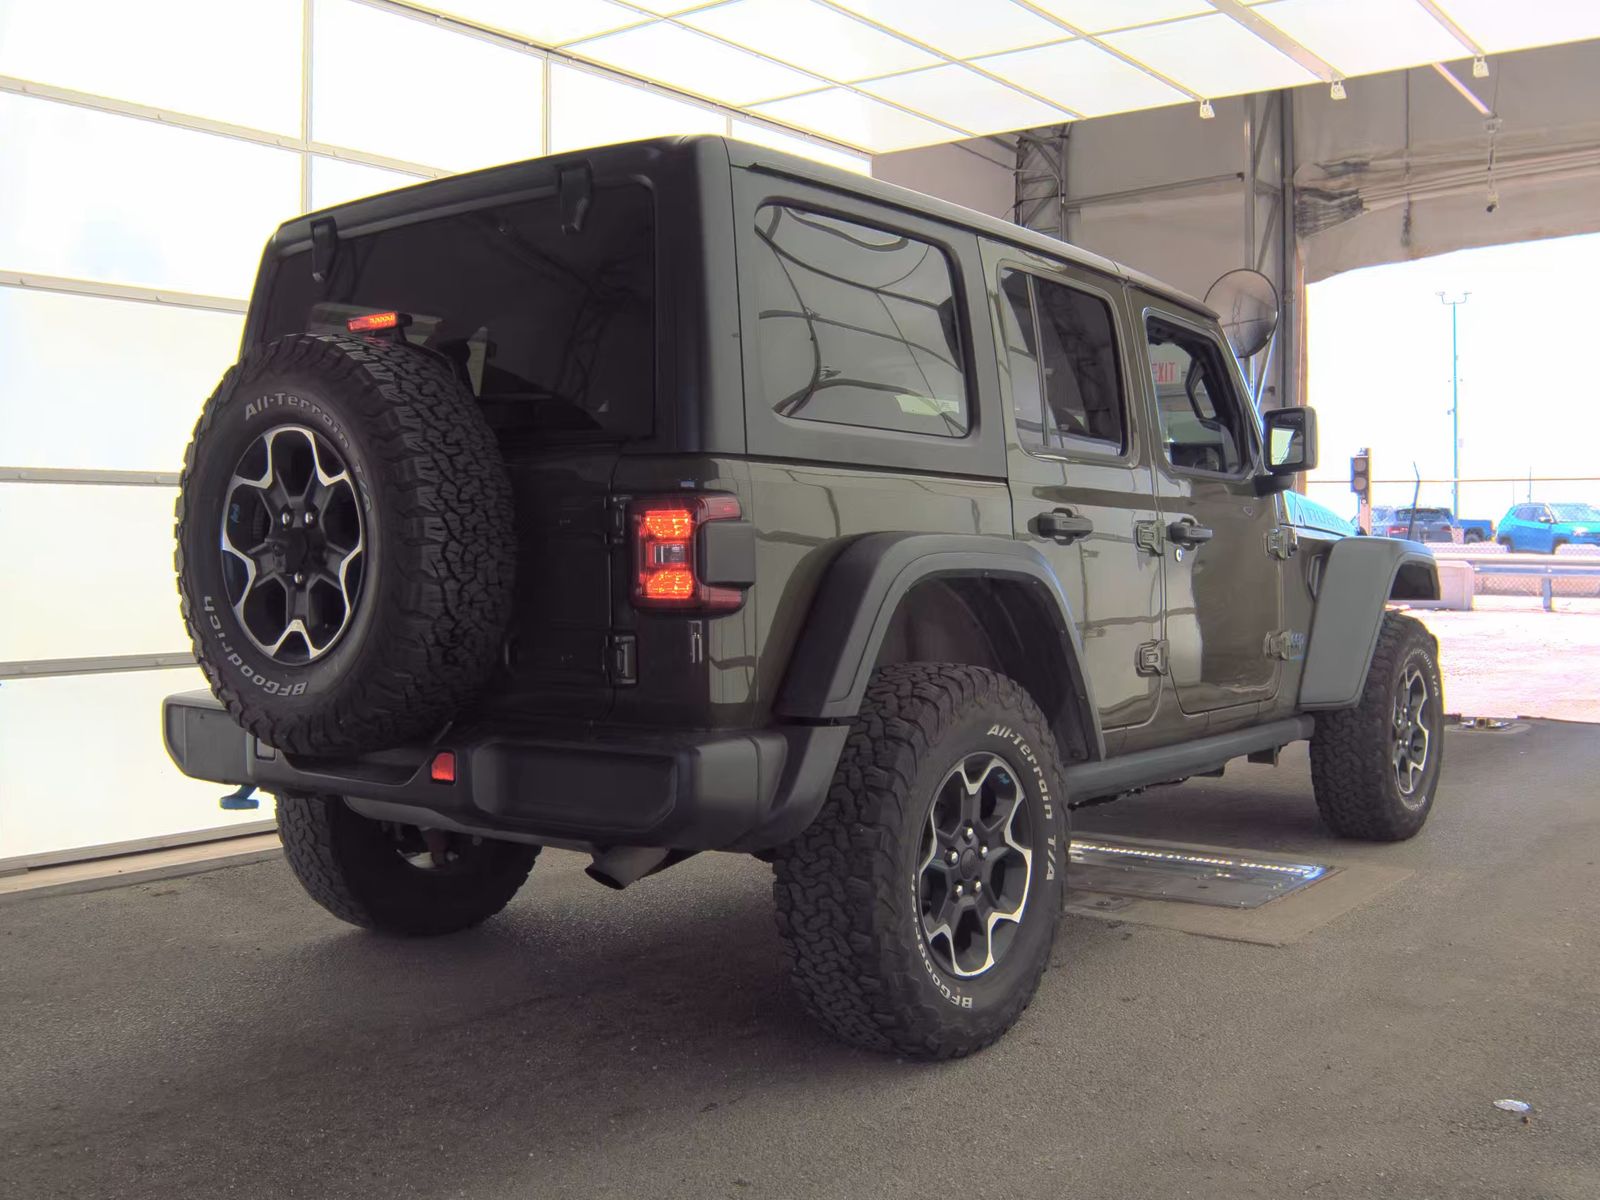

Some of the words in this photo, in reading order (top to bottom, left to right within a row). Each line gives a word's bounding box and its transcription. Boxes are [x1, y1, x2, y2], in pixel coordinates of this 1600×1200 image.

[245, 392, 349, 448] All-Terrain
[1151, 362, 1175, 382] EXIT
[204, 596, 308, 696] BFGoodrich
[986, 723, 1053, 820] All-Terrain
[1045, 834, 1057, 881] T/A
[910, 873, 973, 1009] BFGoodrich
